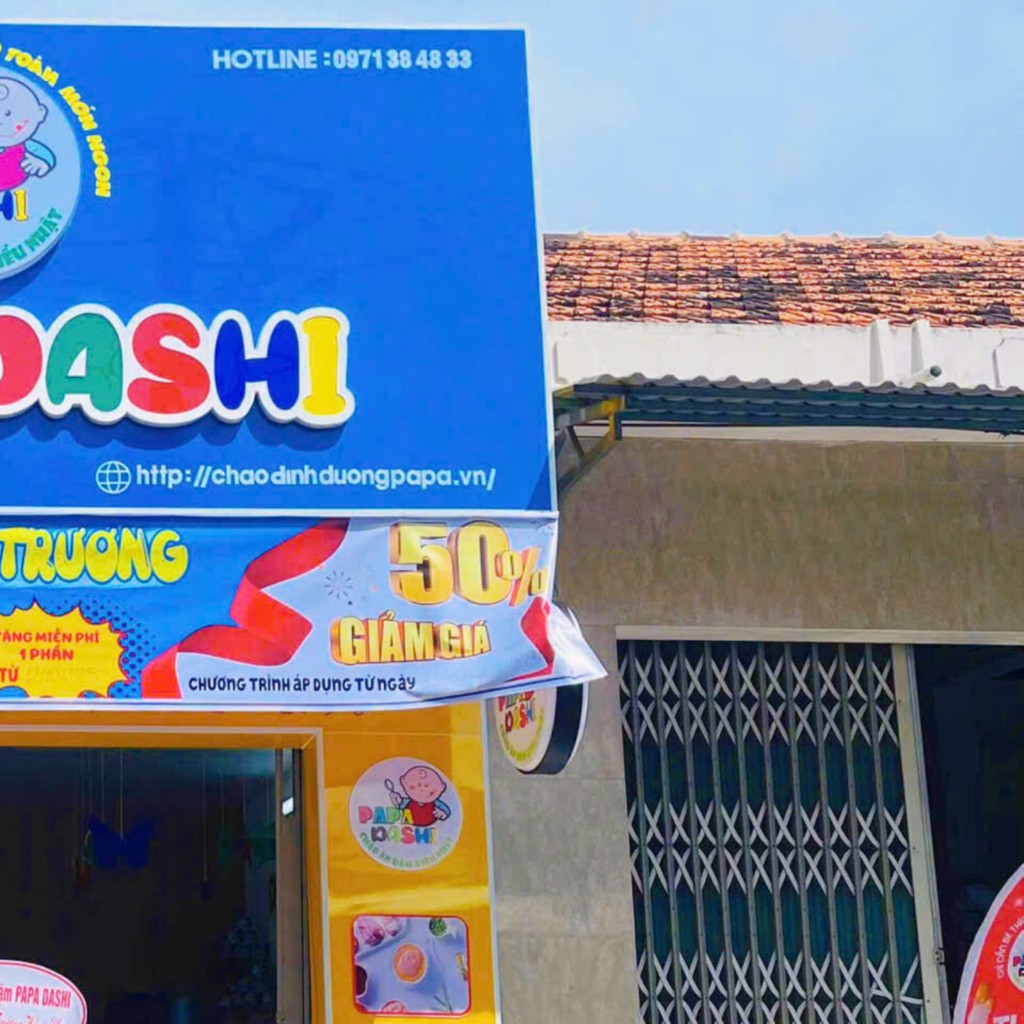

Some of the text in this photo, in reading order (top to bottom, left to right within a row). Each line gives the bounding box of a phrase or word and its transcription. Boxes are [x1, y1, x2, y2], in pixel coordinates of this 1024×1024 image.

[213, 49, 318, 70] HOTLINE
[386, 49, 412, 69] 38
[416, 49, 442, 69] 48
[446, 49, 472, 69] 33
[388, 521, 549, 607] 50%
[330, 610, 491, 665] GIẢM GIÁ
[19, 647, 26, 660] 1
[358, 805, 414, 825] PAPA
[15, 985, 40, 1006] PAPA
[42, 987, 72, 1009] DASHI
